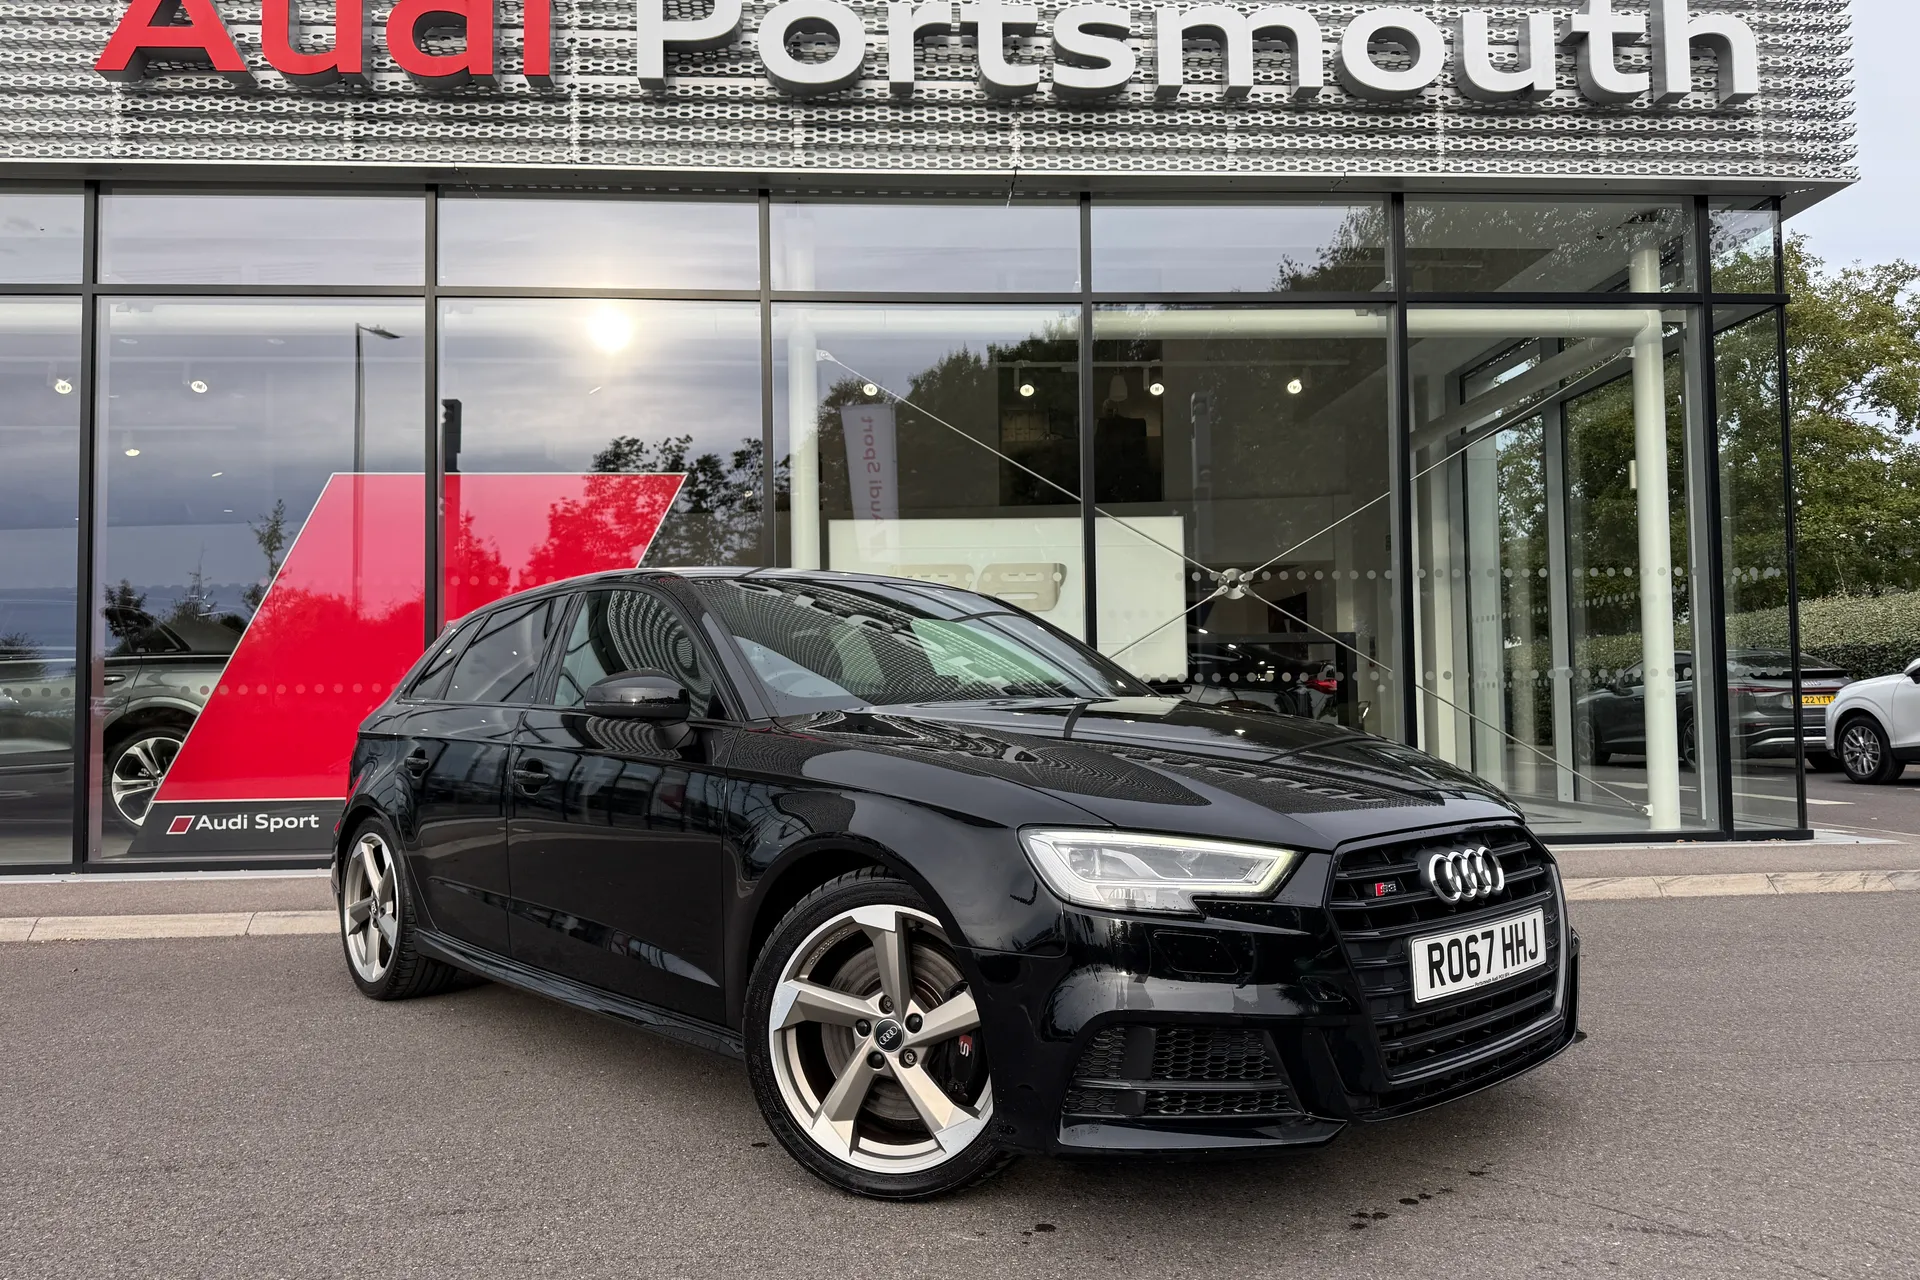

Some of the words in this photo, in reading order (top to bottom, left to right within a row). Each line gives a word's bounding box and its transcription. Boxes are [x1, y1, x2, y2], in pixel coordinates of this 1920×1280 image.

[94, 0, 553, 82] Audi
[637, 0, 1760, 102] Portsmouth
[195, 814, 248, 830] Audi
[254, 813, 320, 833] Sport
[1427, 930, 1495, 989] RO67
[1501, 918, 1539, 969] HHJ
[960, 1041, 969, 1057] S
